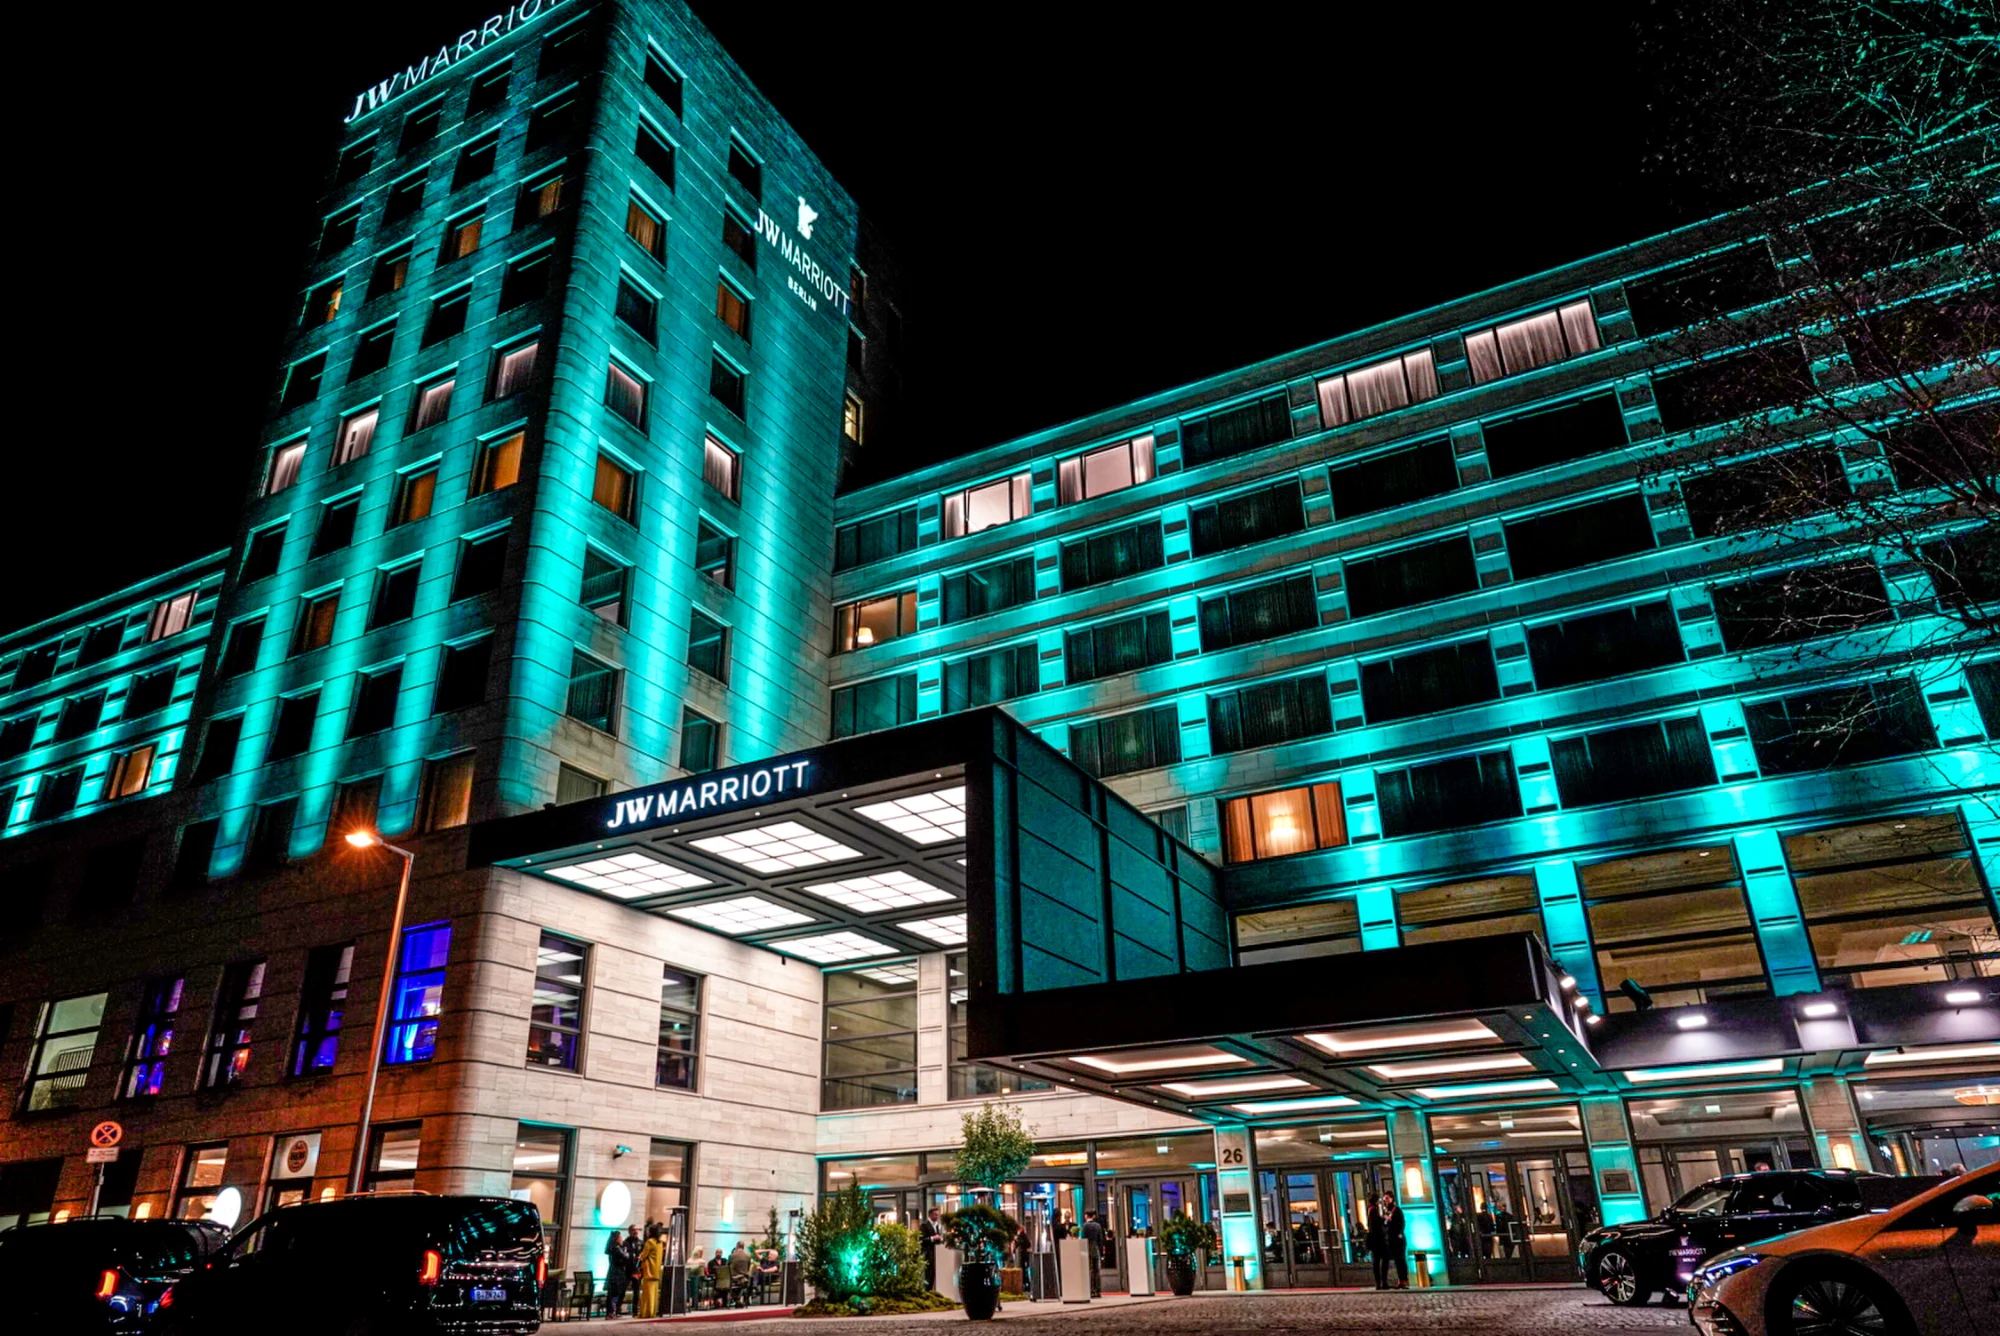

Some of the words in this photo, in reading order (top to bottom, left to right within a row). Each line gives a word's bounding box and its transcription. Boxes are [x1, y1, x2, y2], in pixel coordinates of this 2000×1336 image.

[343, 72, 401, 123] JW
[403, 0, 555, 91] MARRIO
[753, 207, 780, 247] JW
[781, 231, 850, 316] MARRIOTT
[788, 275, 817, 312] BERLIN
[606, 795, 654, 828] JW
[656, 760, 810, 818] MARRIOTT
[1222, 1148, 1243, 1164] 26
